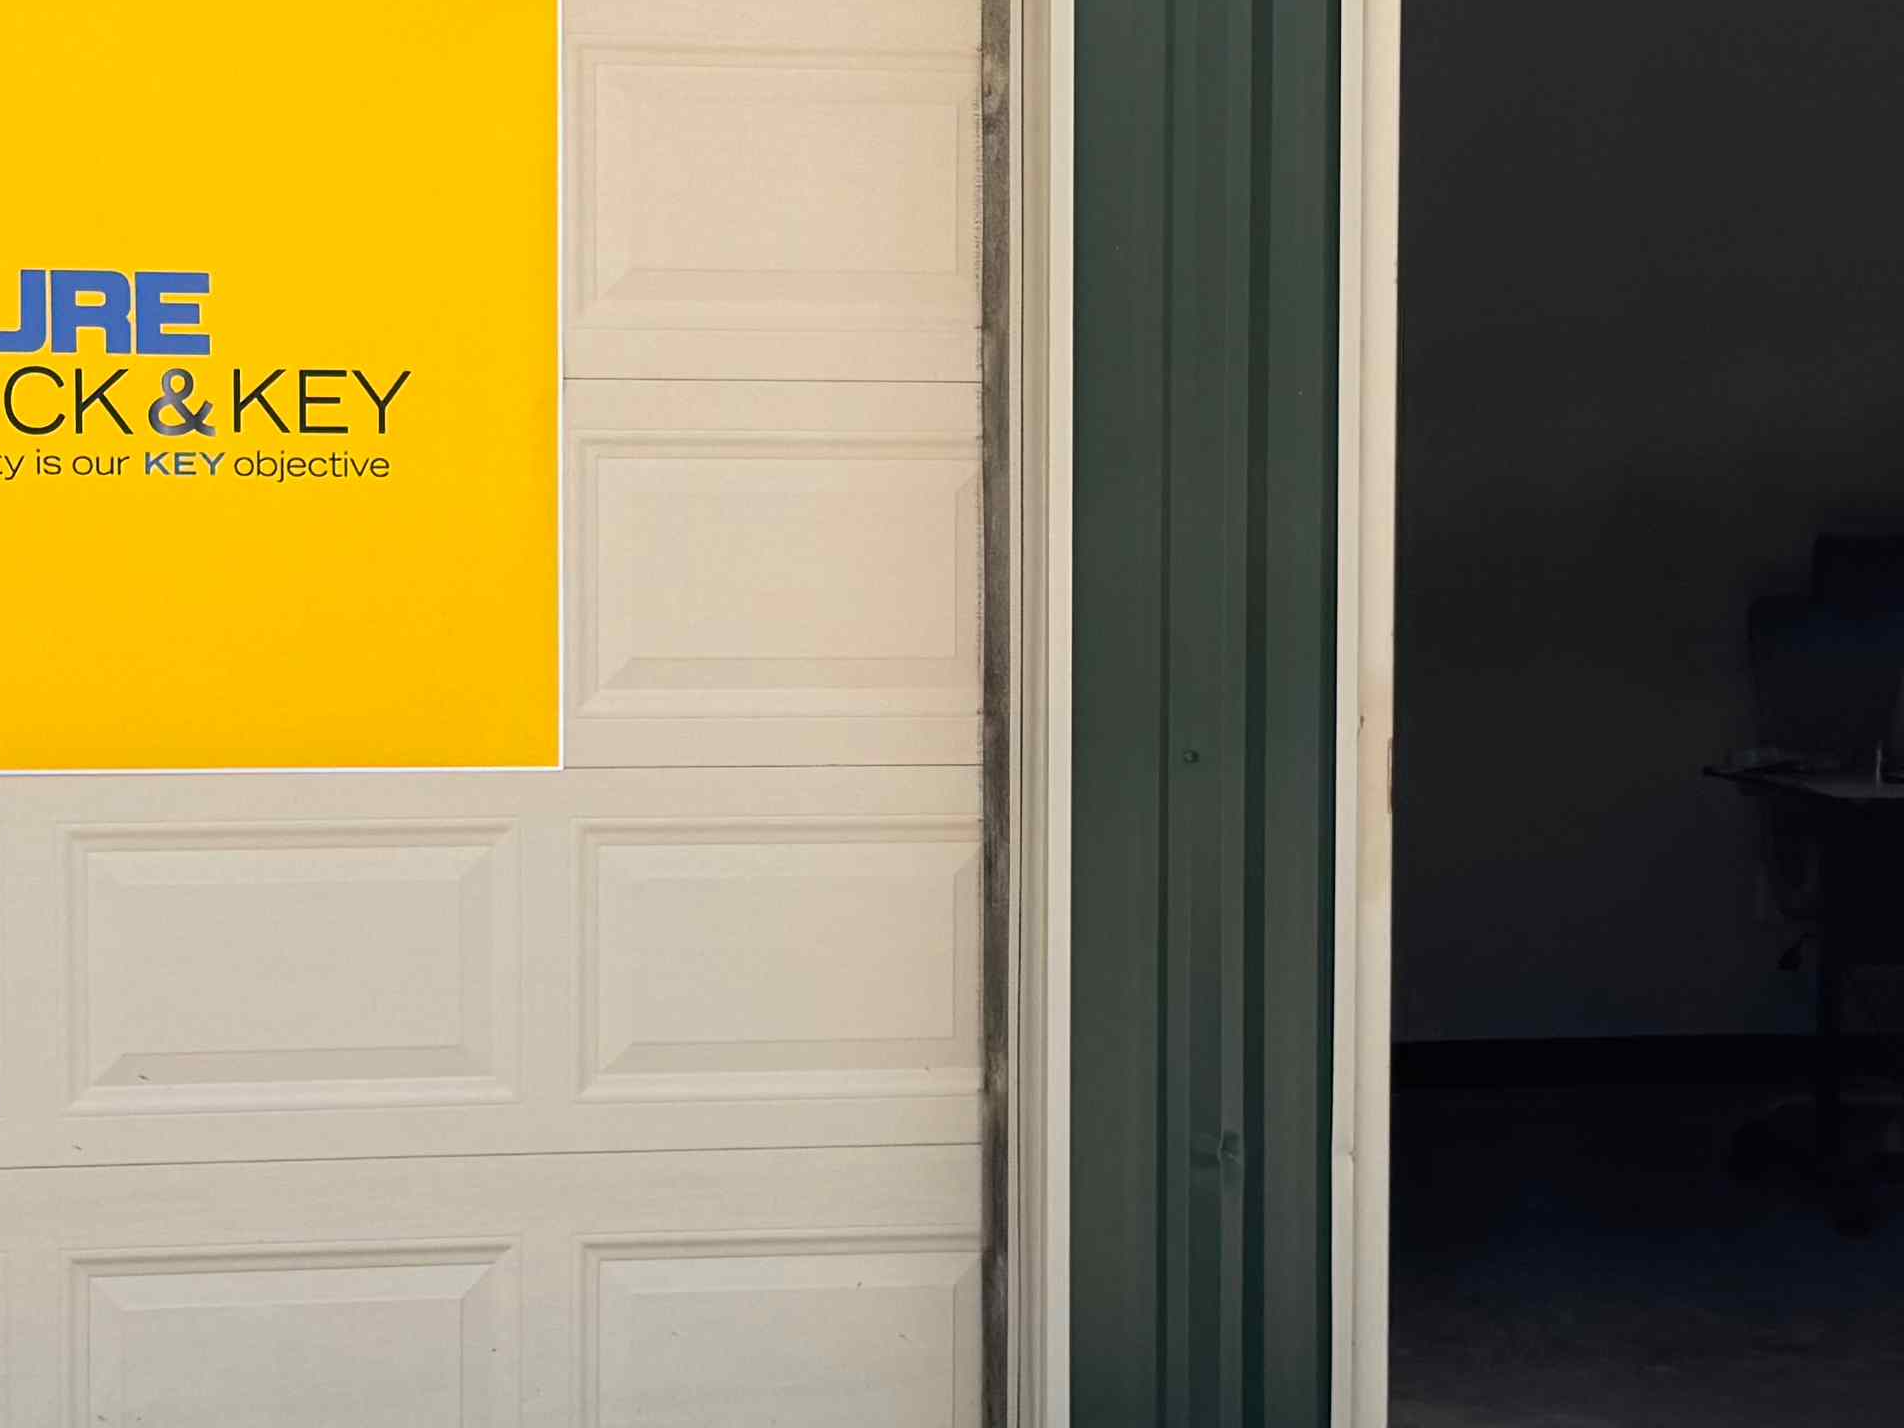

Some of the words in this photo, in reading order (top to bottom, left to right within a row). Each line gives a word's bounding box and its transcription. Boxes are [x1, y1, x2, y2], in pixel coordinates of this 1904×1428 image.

[147, 367, 217, 438] &
[232, 368, 412, 435] KEY
[35, 448, 62, 476] is
[72, 455, 130, 476] our
[144, 451, 225, 477] KEY
[233, 450, 390, 483] objective
